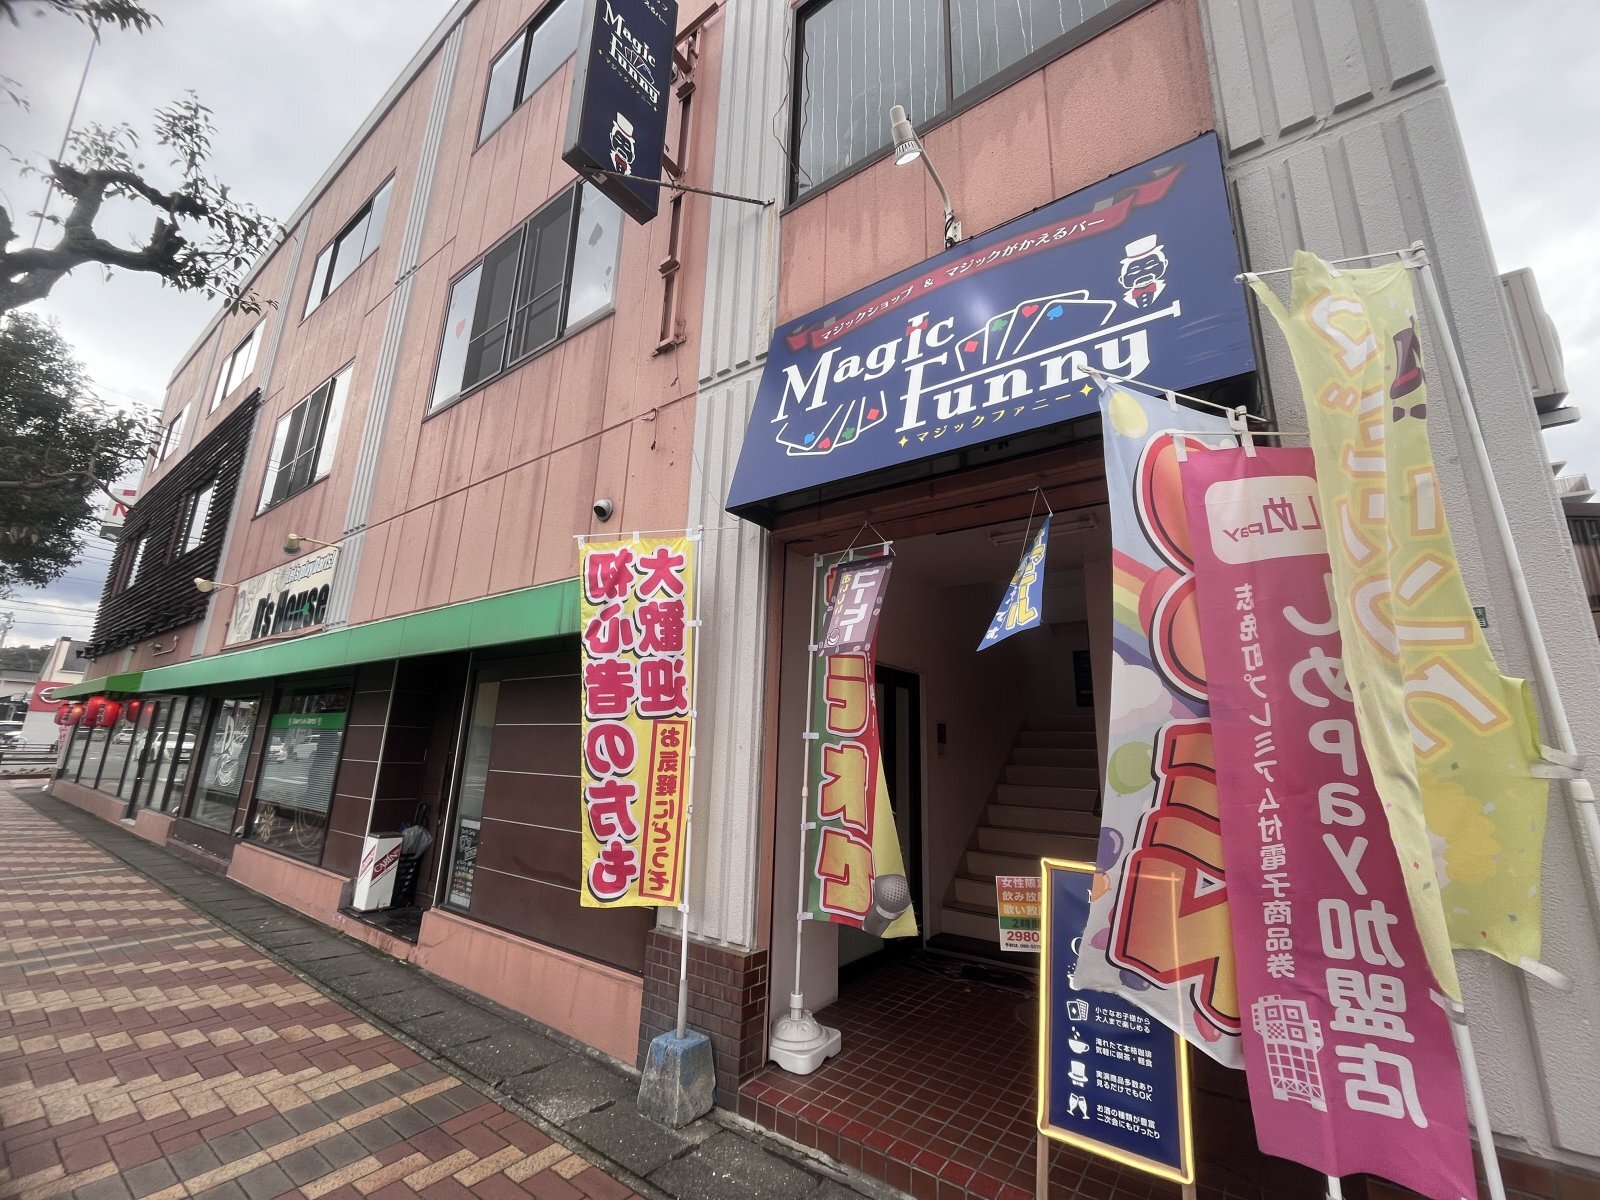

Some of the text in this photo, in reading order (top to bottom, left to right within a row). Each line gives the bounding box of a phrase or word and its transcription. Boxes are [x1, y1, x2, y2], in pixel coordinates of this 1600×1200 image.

[602, 0, 657, 68] Magic
[608, 33, 661, 104] Funny
[819, 217, 1106, 342] マジックショップ & マジックがかえるバー
[770, 310, 957, 425] Magic
[895, 310, 1168, 434] Funny
[916, 393, 1072, 443] マジックファニー
[271, 583, 330, 636] House
[1006, 931, 1040, 942] 2980
[1095, 1006, 1151, 1026] 小さなお子様から
[1095, 1015, 1151, 1034] 大人まで楽しめる
[1096, 1079, 1153, 1101] 見るだけでもOK
[1097, 1104, 1156, 1129] お酒の種類が豊富
[1097, 1113, 1160, 1140] 二次会にもぴったり
